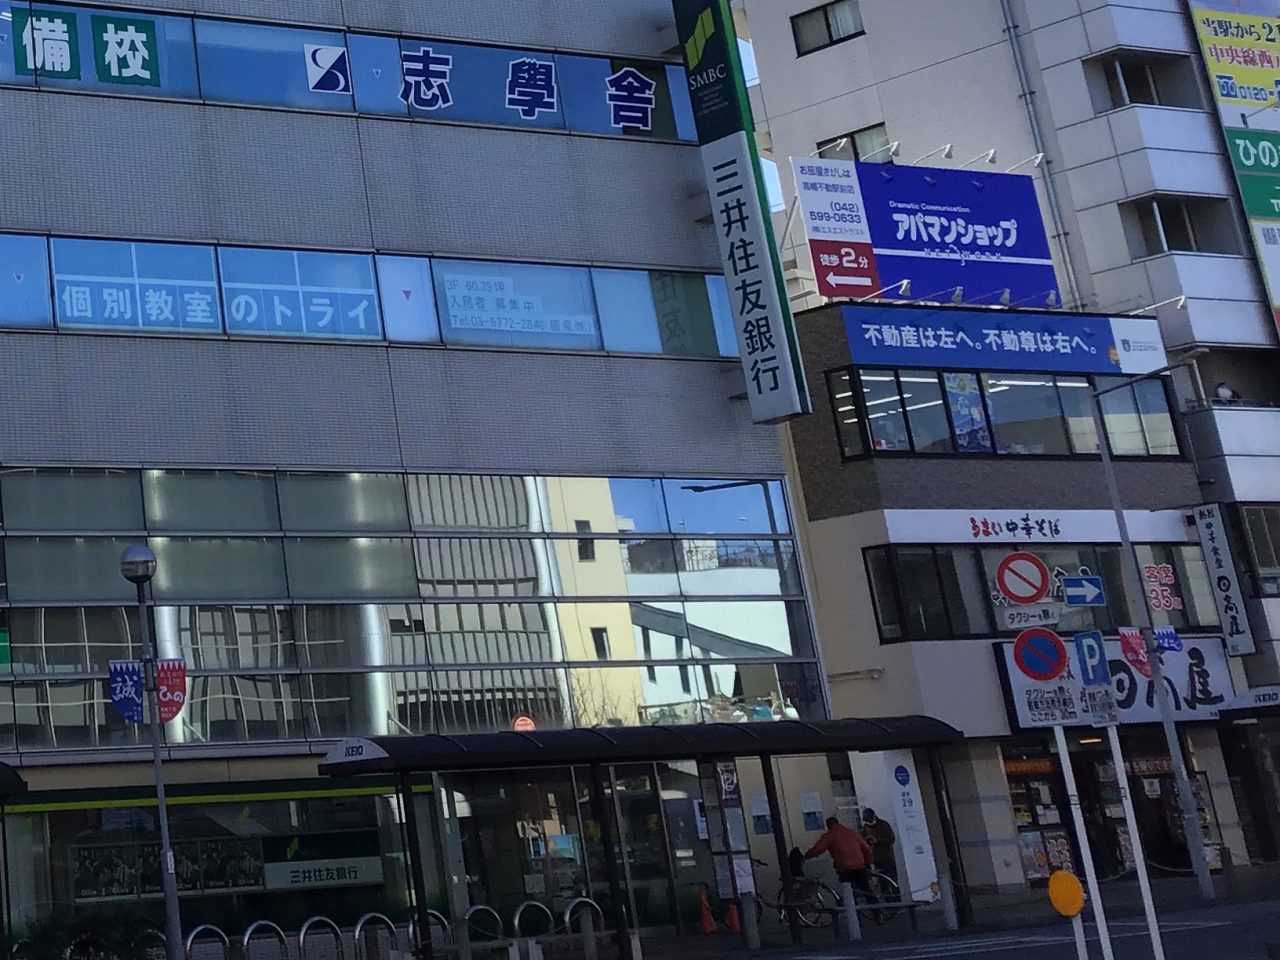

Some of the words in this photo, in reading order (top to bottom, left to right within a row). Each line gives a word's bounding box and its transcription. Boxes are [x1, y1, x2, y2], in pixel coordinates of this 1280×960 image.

[1202, 16, 1280, 44] 当駅から2
[1209, 43, 1280, 70] 中央線西
[689, 63, 728, 91] SMBC
[1236, 139, 1280, 168] ひの
[800, 165, 852, 178] お部屋さがしは
[809, 211, 862, 224] 599-0633
[830, 201, 860, 214] (042)
[888, 200, 920, 211] Dramatic
[921, 202, 971, 214] Communication
[892, 212, 1019, 248] アパマンショップ
[819, 247, 869, 269] 徒歩2分
[712, 158, 782, 396] 三井住友銀行
[62, 285, 370, 331] 個別教室のトライ
[969, 514, 1061, 538] うまい中華そば
[1084, 638, 1101, 681] P
[111, 675, 141, 704] 誠
[159, 685, 184, 703] ひの
[343, 744, 365, 757] KEIO
[289, 865, 359, 883] 三井住友銀行
